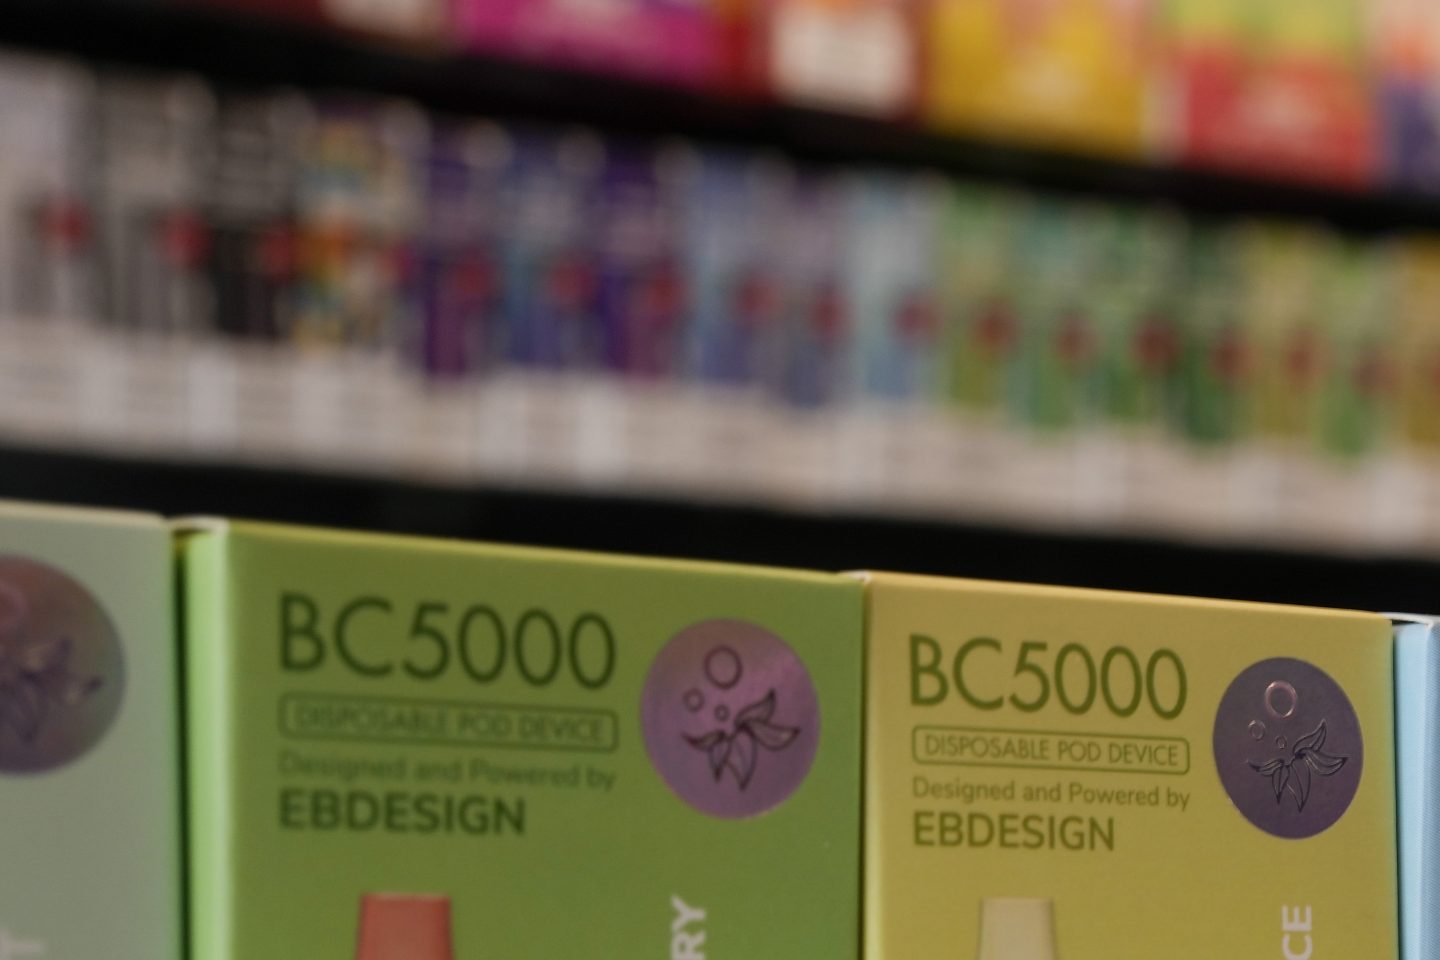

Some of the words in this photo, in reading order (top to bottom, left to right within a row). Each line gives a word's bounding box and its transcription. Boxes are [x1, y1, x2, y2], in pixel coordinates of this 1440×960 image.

[279, 591, 616, 689] BC5000
[909, 634, 1188, 721] BC5000
[925, 734, 1049, 761] DISPOSABLE
[1058, 740, 1101, 763] POD
[1108, 742, 1178, 767] DEVICE
[279, 788, 525, 834] EBDESIGN
[912, 776, 1016, 805] Designed
[1023, 781, 1061, 802] and
[1068, 782, 1160, 807] Powered
[1166, 787, 1190, 812] by
[912, 810, 1115, 851] EBDESIGN
